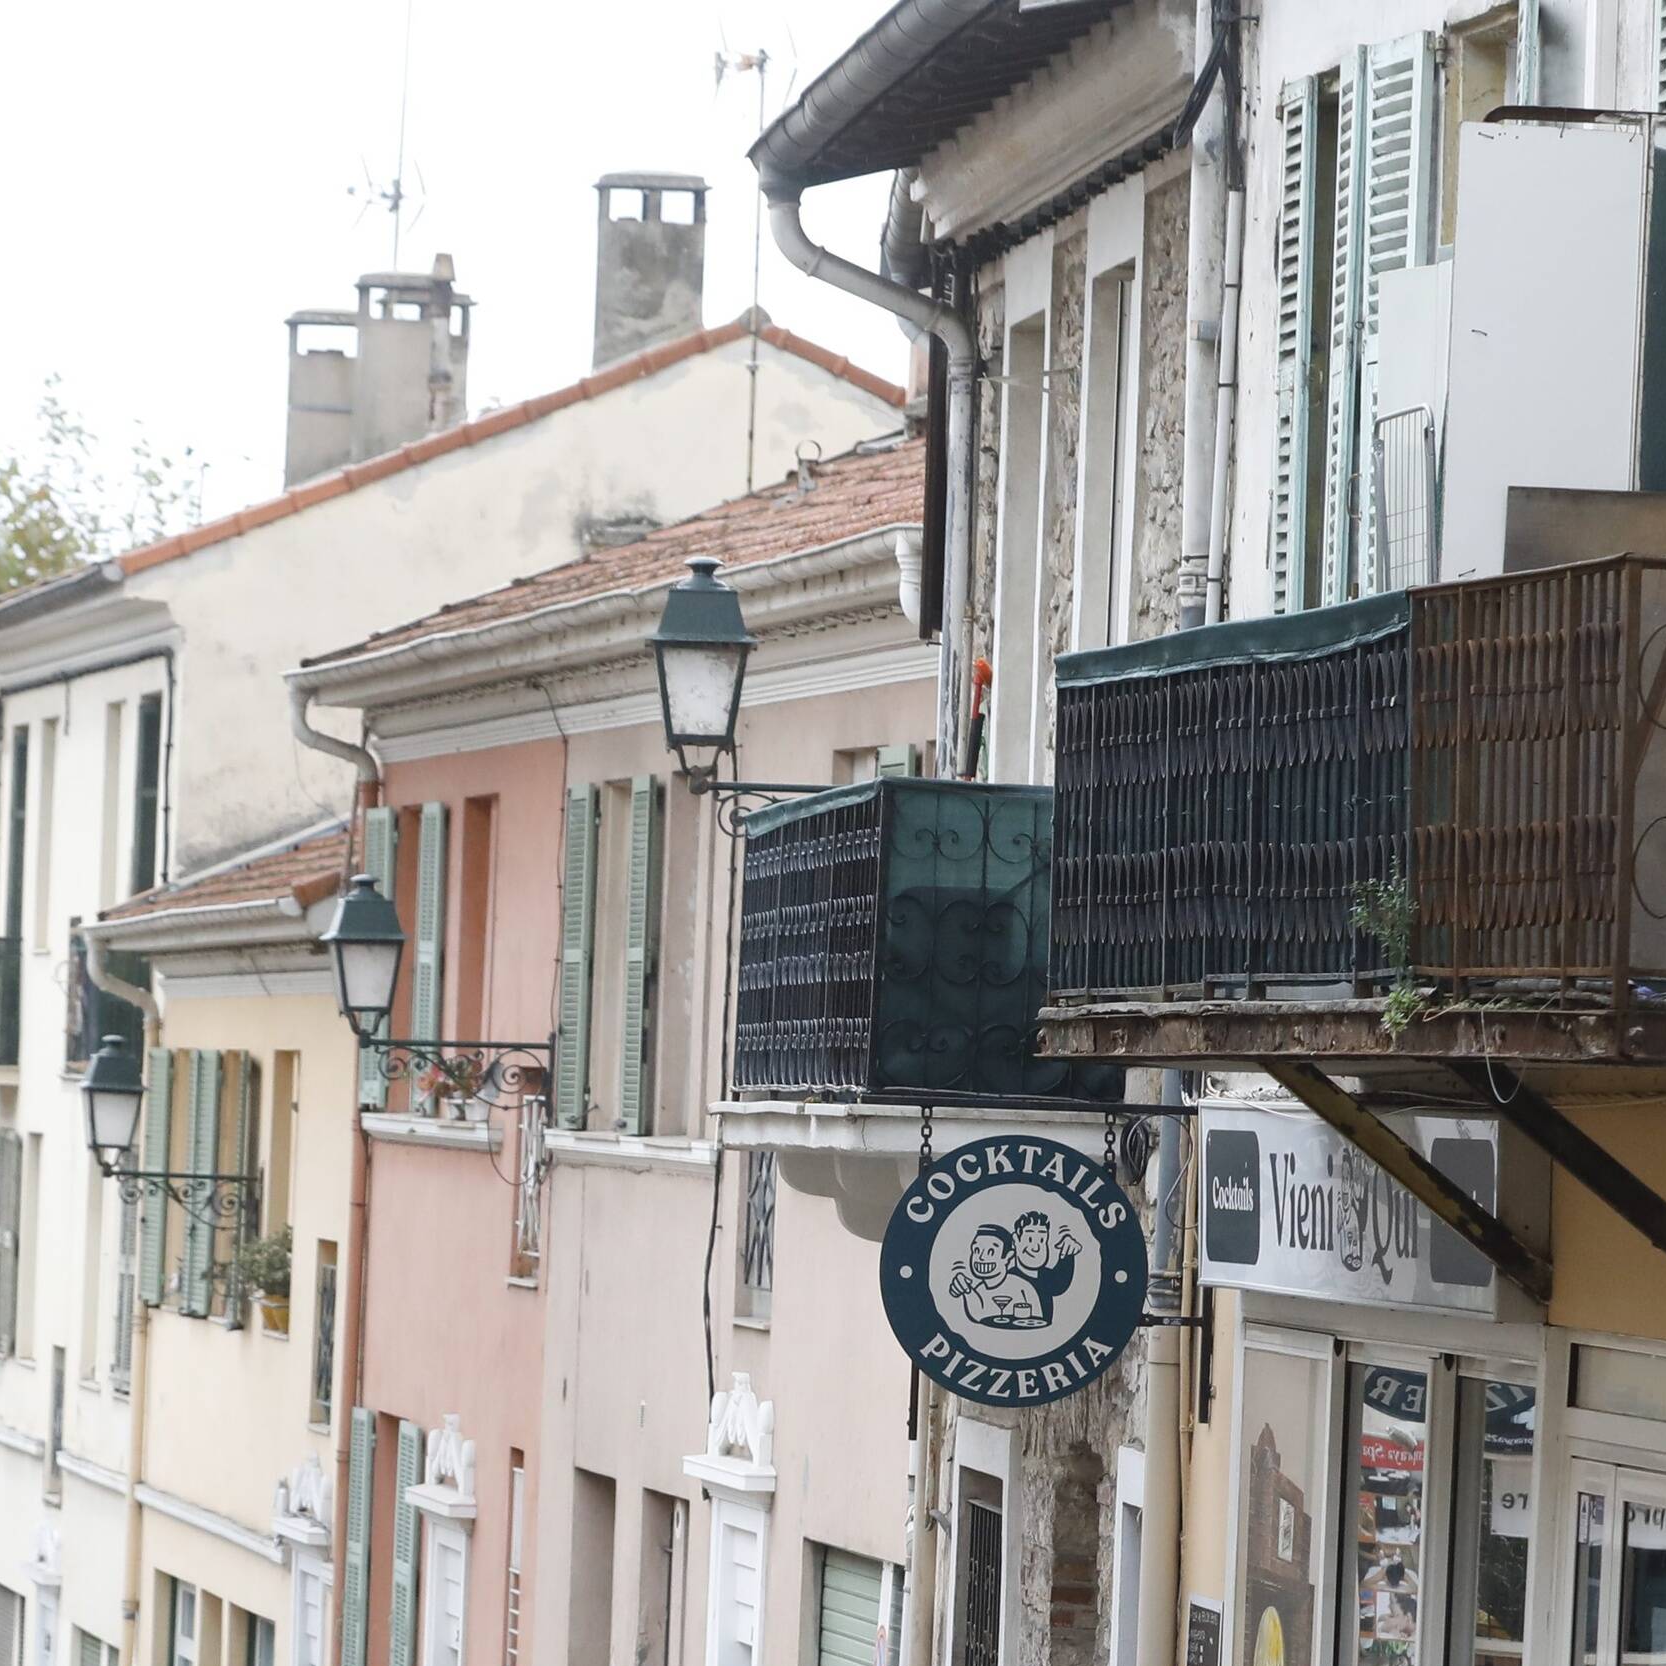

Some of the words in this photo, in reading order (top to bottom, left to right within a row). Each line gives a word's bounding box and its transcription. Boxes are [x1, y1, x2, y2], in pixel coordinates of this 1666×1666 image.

[906, 1144, 1127, 1229] COCKTAILS
[1212, 1172, 1254, 1213] Cocktails
[1269, 1151, 1334, 1252] Vieni
[919, 1331, 1115, 1399] PIZZERIA
